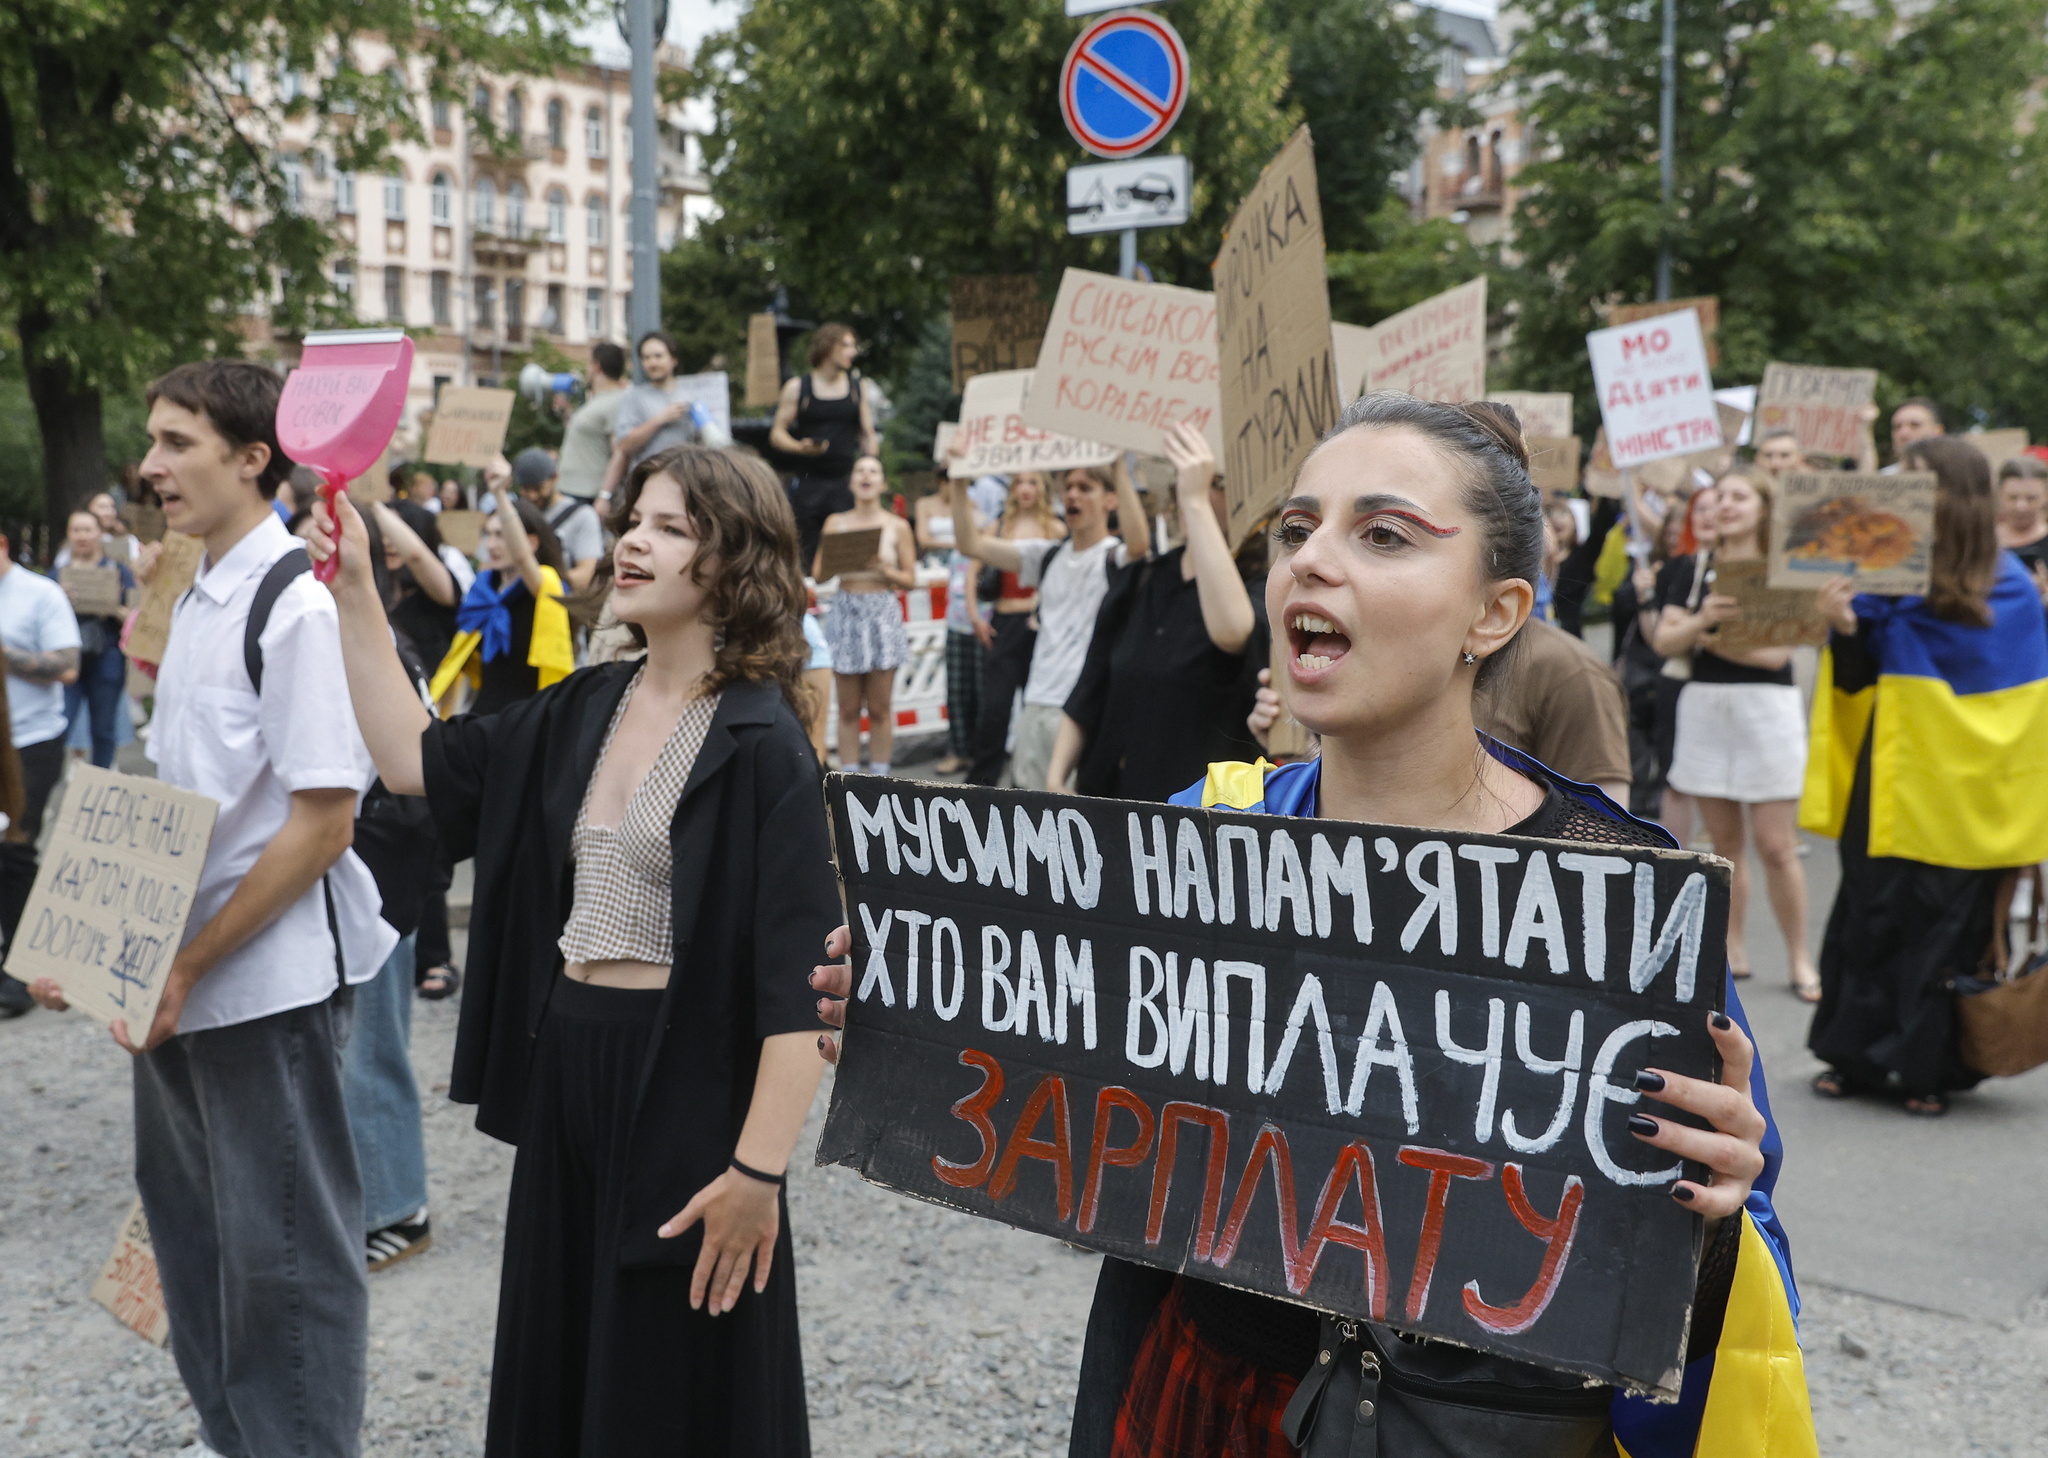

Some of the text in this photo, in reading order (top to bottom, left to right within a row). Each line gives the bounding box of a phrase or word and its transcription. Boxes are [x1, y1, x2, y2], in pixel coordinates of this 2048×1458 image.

[1070, 282, 1218, 344] СИРСЬКОГ
[1239, 302, 1272, 404] НА
[1620, 327, 1671, 360] МО
[1056, 374, 1212, 433] КОРАБЛЕМ
[50, 851, 135, 909] КАРТОН
[846, 791, 1706, 1002] МУСИМО НАПАМ'ЯТАТИ
[857, 902, 1684, 1186] ХТО ВАМ ВИПЛАЧУЄ
[931, 1048, 1584, 1335] ЗАРПЛАТУ
